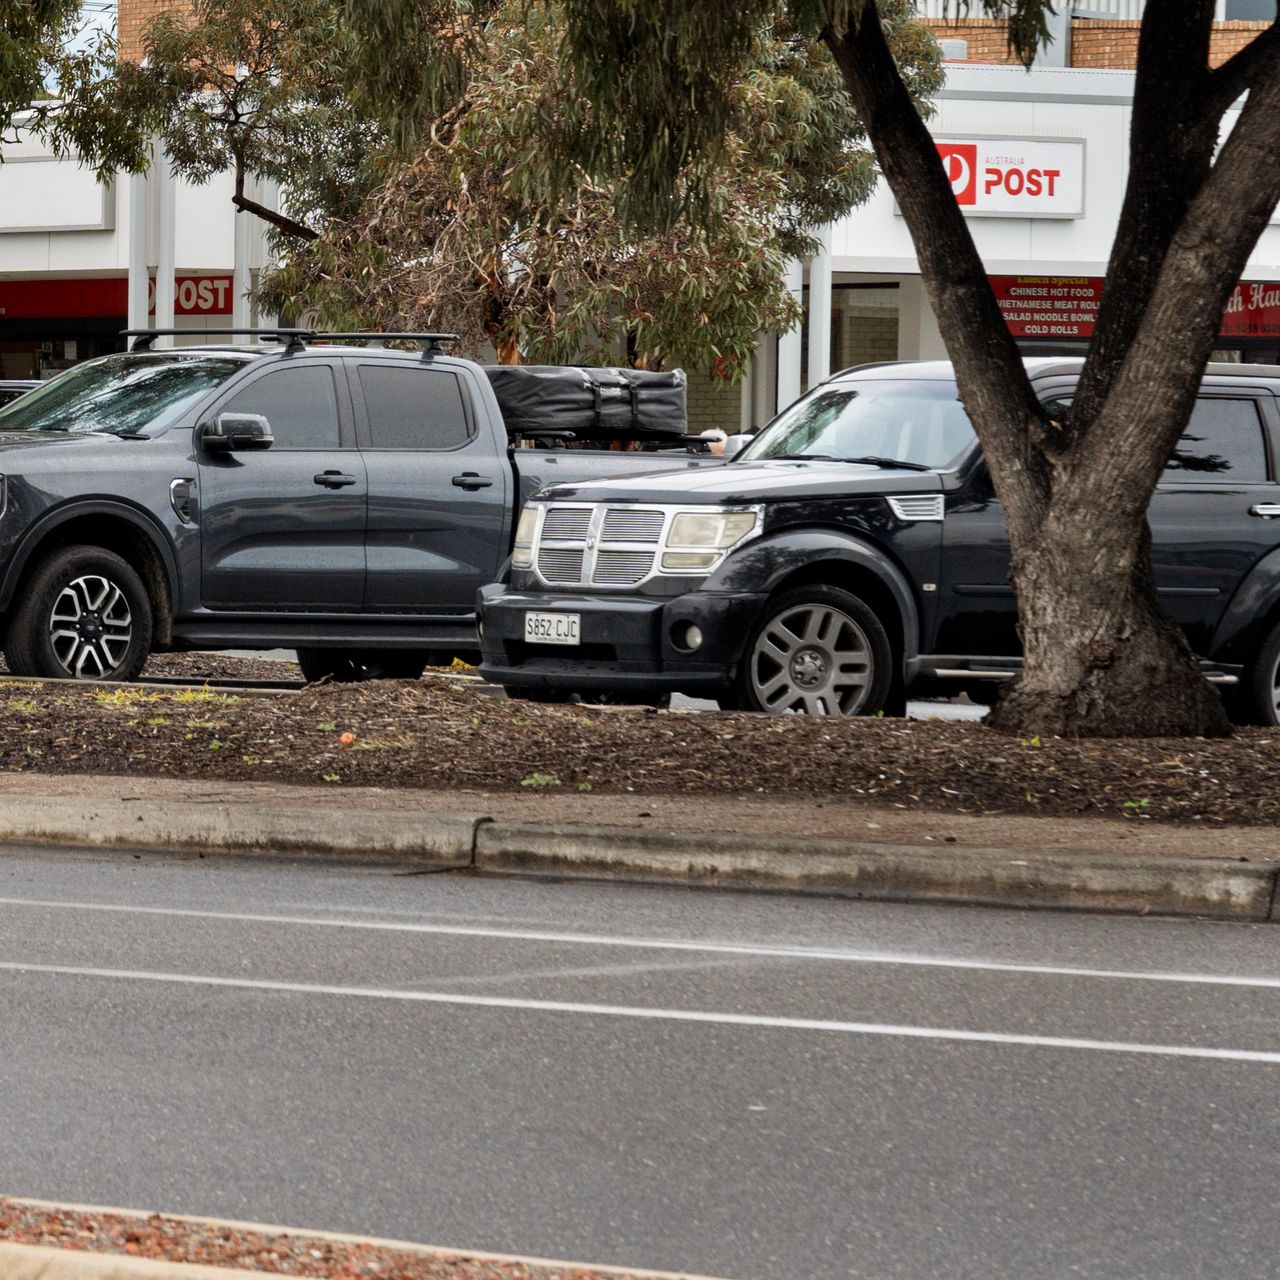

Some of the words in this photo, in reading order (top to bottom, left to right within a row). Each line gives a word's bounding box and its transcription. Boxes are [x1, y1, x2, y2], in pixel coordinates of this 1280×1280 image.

[985, 156, 1025, 165] AUSTRALIA
[985, 168, 1060, 197] POST
[174, 279, 230, 310] OST
[1010, 287, 1048, 296] CHINESE
[1050, 288, 1069, 296] HOT
[1071, 288, 1094, 297] FOOD
[998, 300, 1052, 308] VIETNAMESE
[1054, 301, 1078, 309] MEAT
[1003, 312, 1031, 320] SALAD
[1033, 313, 1069, 321] NOODLE
[1071, 314, 1098, 322] BOWL
[1024, 325, 1048, 333] COLD
[1050, 325, 1078, 334] ROLLS
[527, 618, 552, 637] S852
[556, 619, 577, 638] CJC
